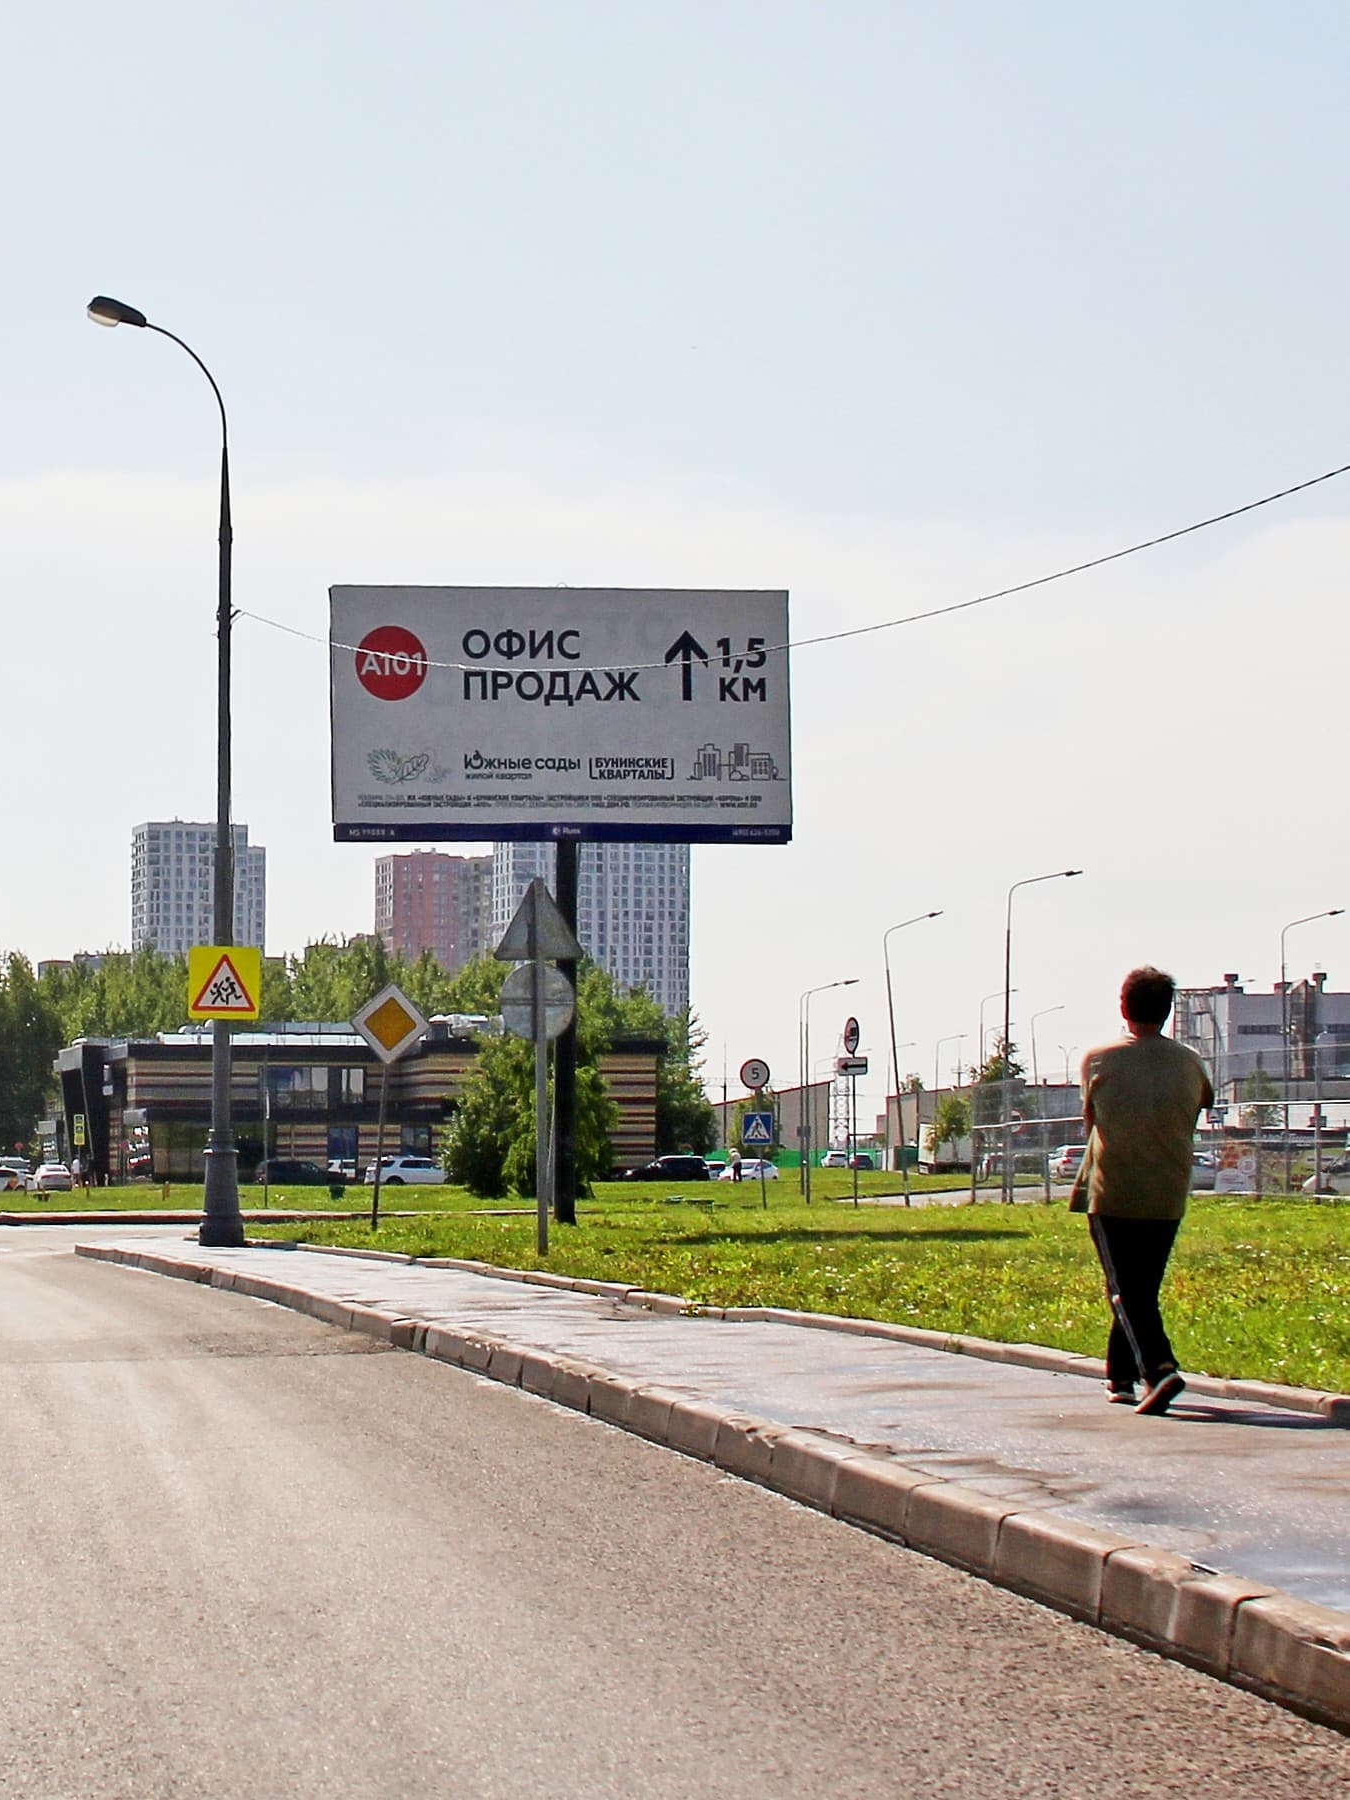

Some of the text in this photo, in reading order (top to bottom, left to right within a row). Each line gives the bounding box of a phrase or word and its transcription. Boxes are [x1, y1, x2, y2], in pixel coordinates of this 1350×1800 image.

[462, 628, 581, 660] ОФИС
[716, 637, 767, 674] 1,5
[463, 671, 641, 706] ПРОДАЖ
[464, 750, 581, 772] Южные сады
[595, 757, 668, 769] БУНИНСКИЕ
[599, 769, 666, 781] КВАРТАЛЫ
[751, 1067, 760, 1080] 5
